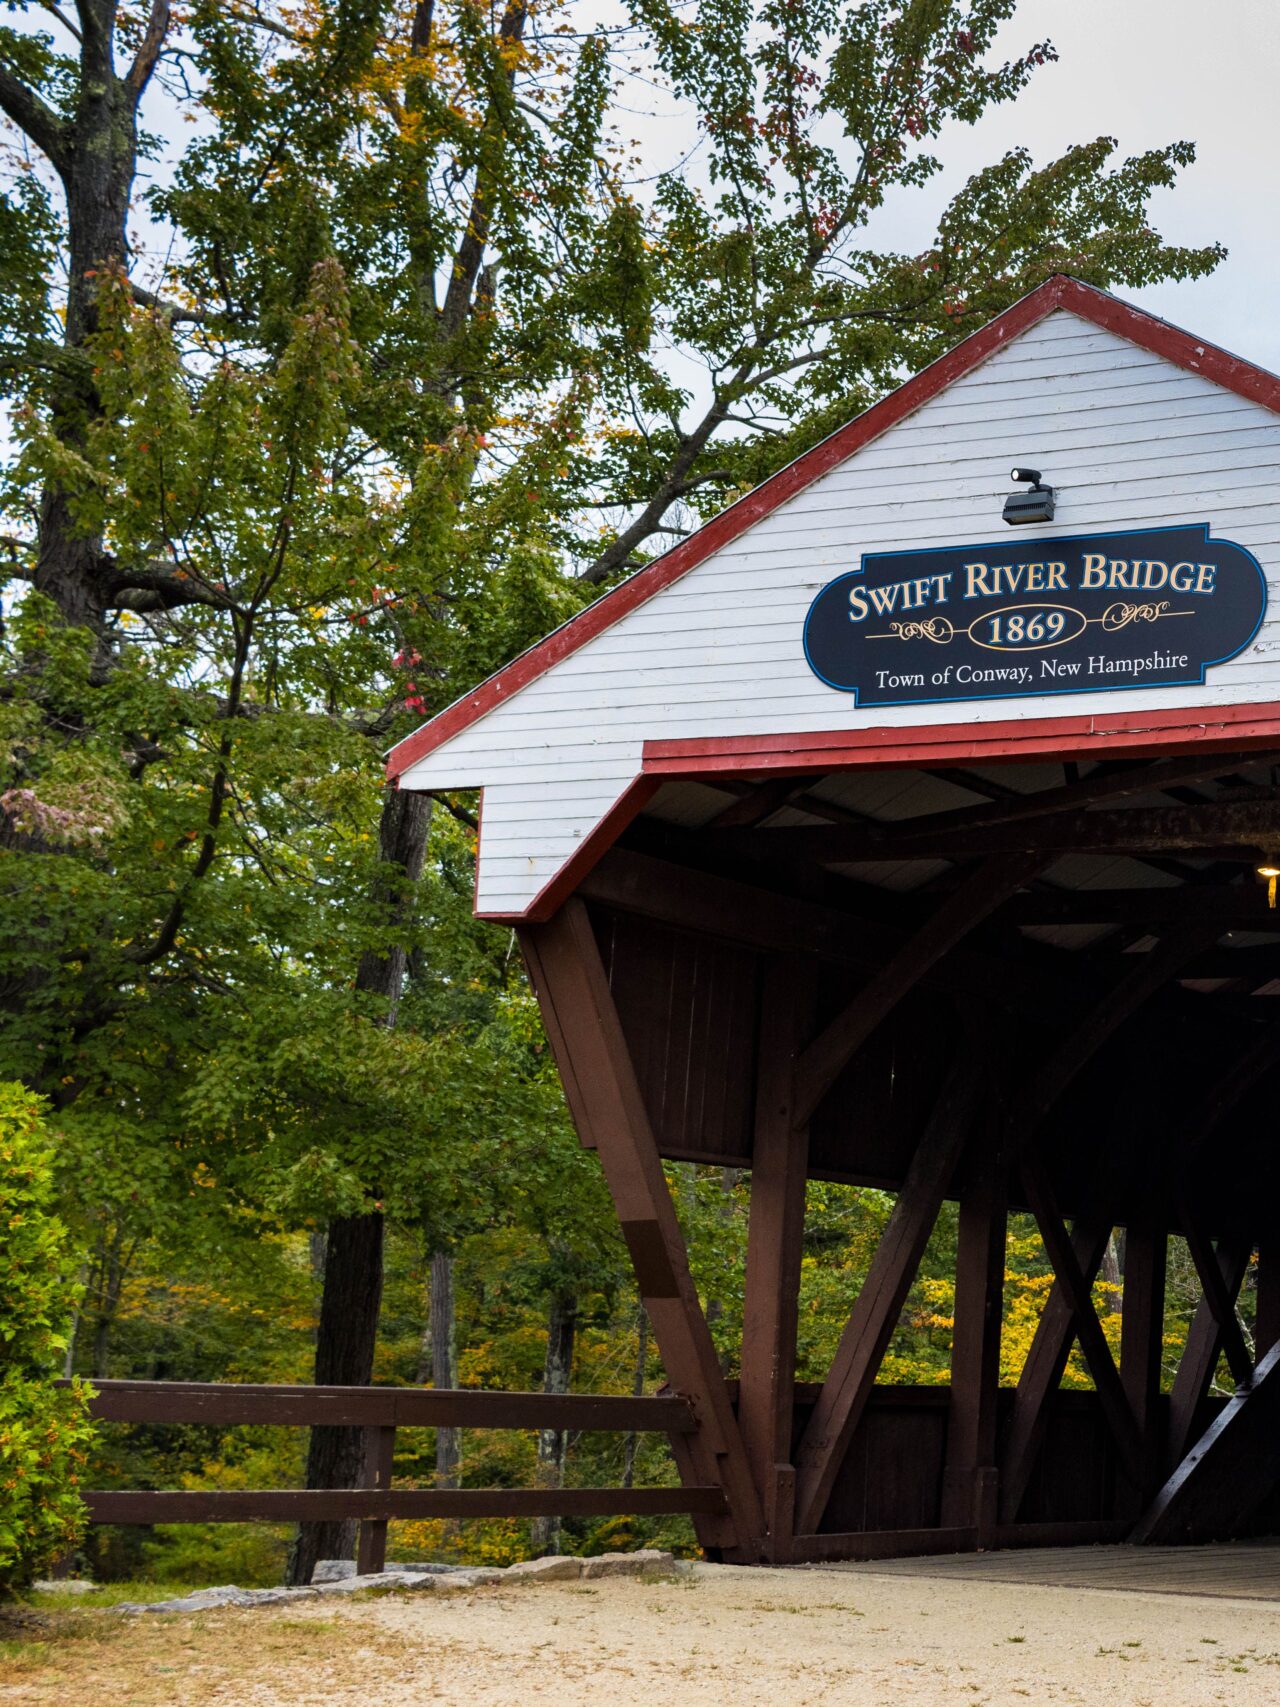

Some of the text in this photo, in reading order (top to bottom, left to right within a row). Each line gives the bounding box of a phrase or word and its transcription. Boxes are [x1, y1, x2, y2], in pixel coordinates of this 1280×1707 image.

[848, 554, 1216, 622] SWIFT RIVER BRIDGE
[988, 611, 1065, 643] 1869
[875, 649, 1188, 689] Town of Conway, New Hampshire
